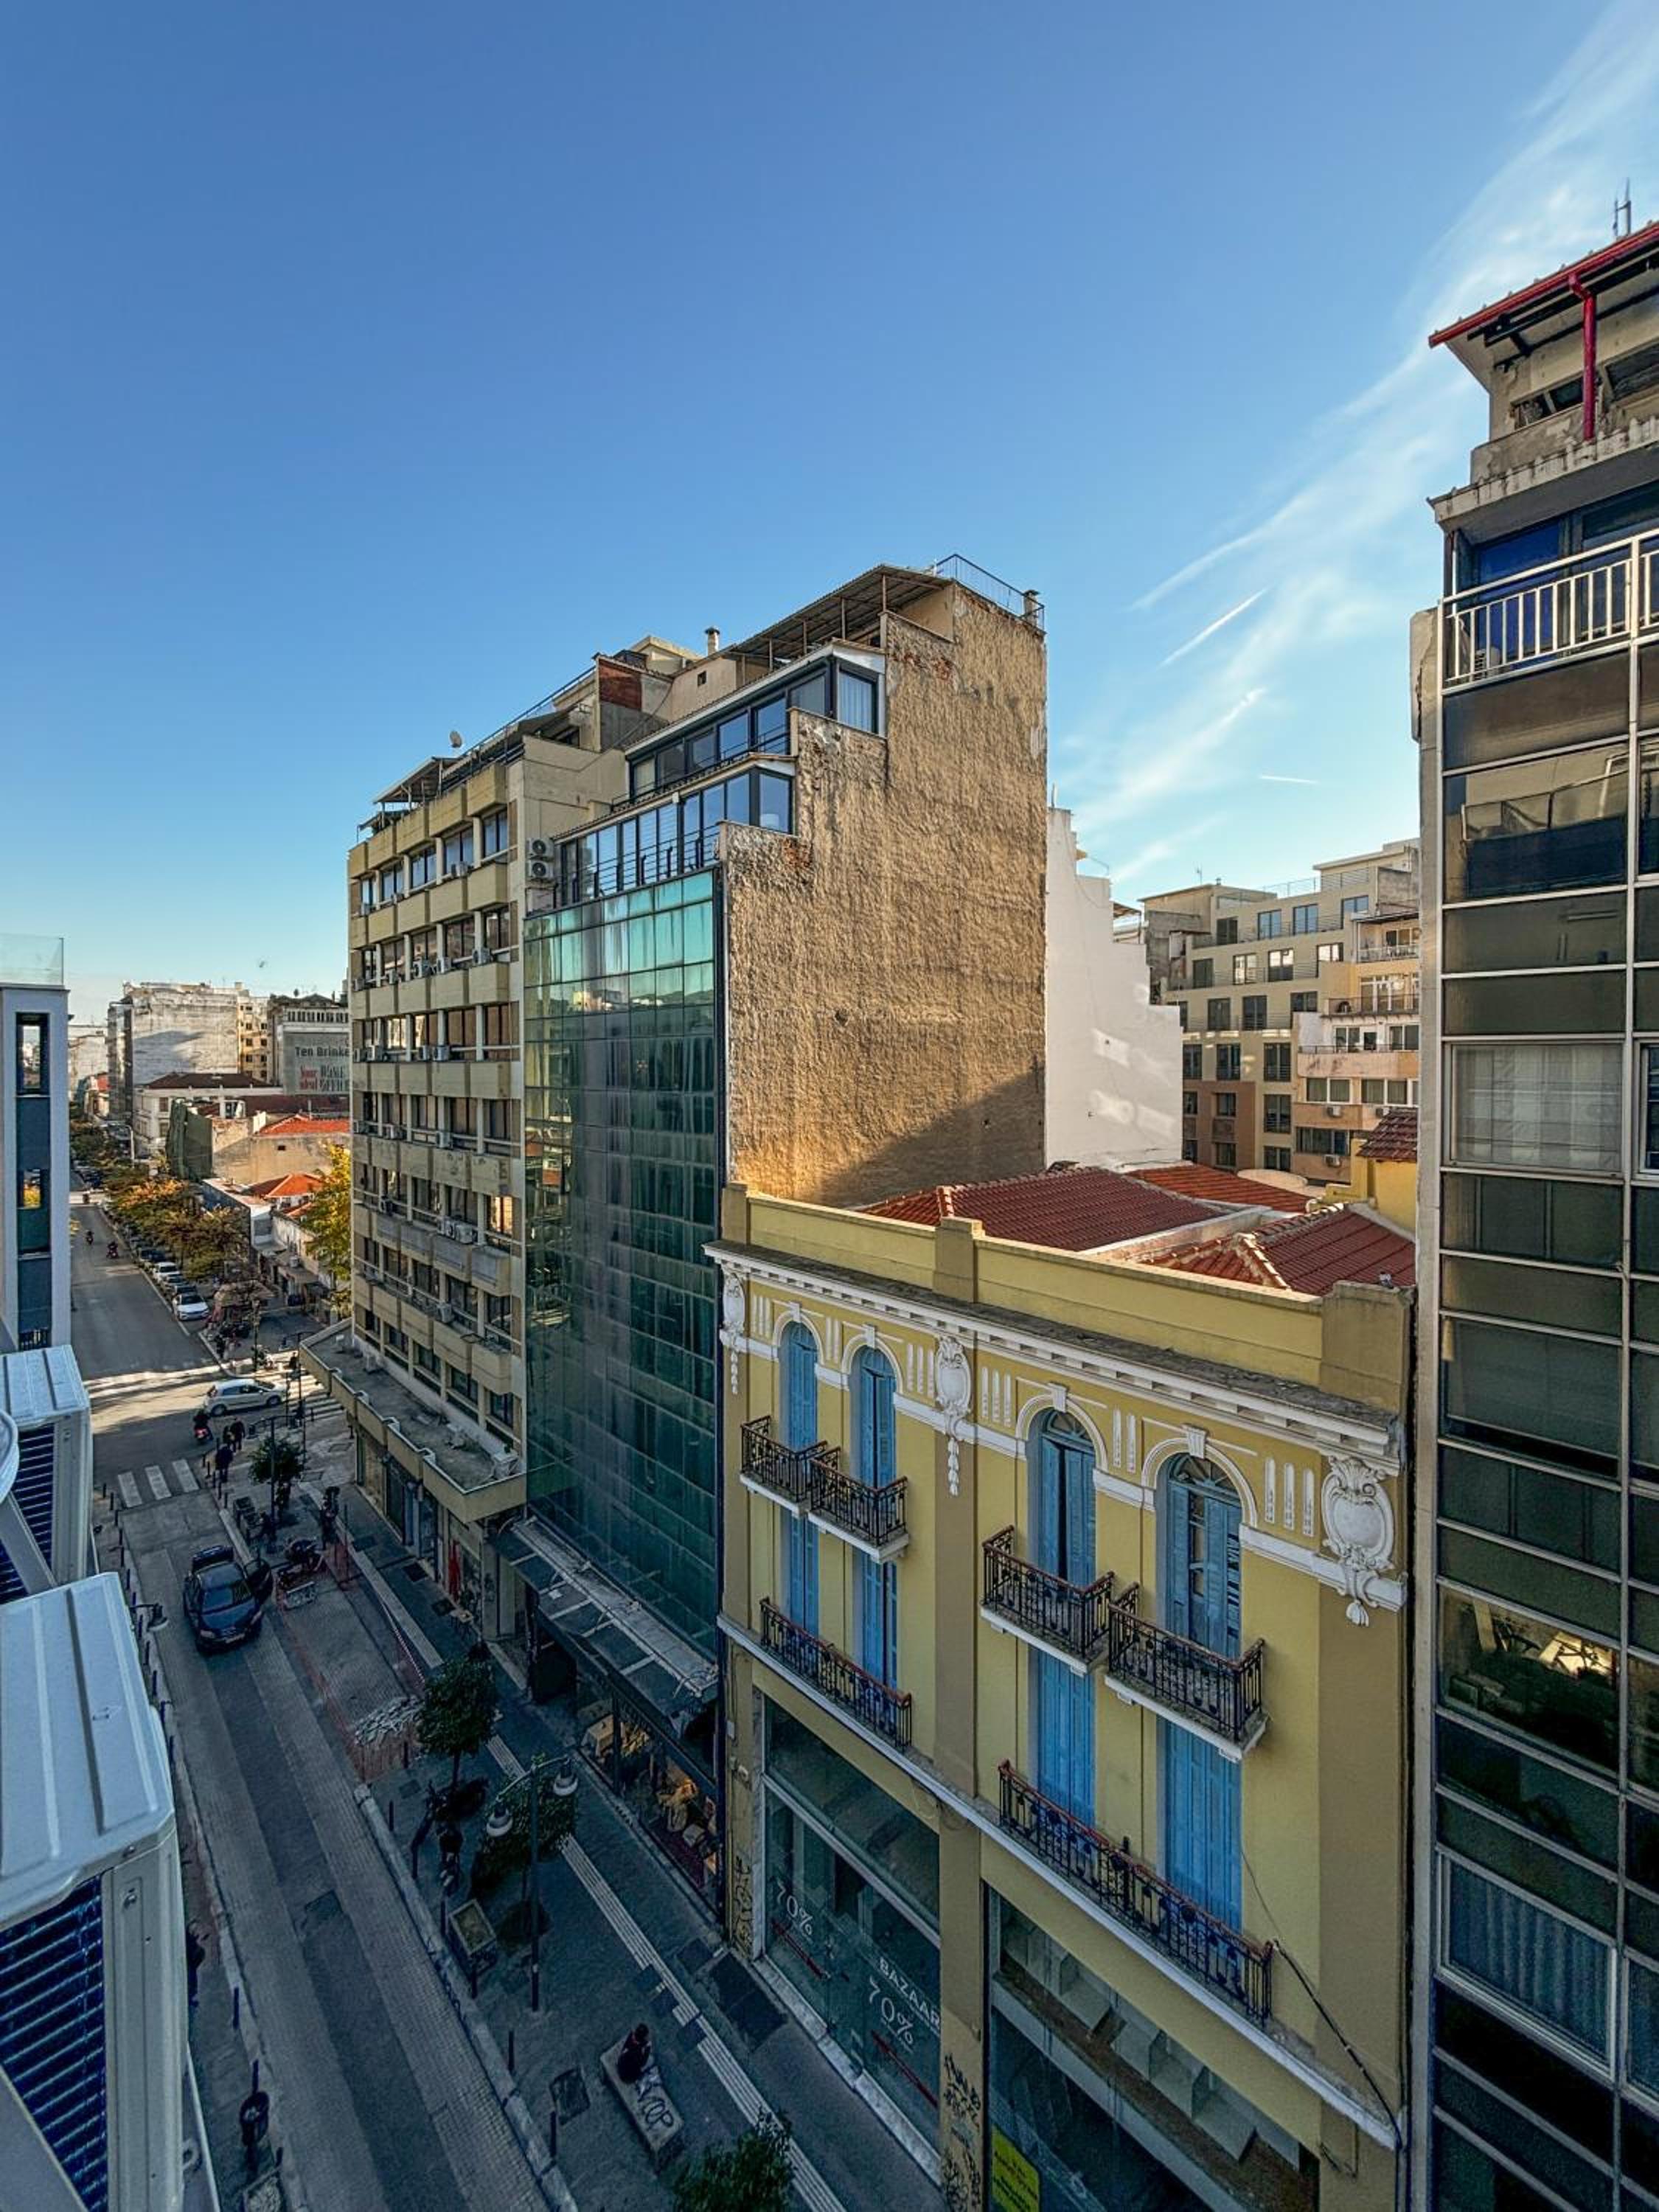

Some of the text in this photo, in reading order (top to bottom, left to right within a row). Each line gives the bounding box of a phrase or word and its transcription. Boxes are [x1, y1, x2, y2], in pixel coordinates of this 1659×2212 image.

[295, 1045, 349, 1057] Ten Brinke
[869, 1976, 914, 2045] 70%
[879, 1956, 940, 2029] BAZAAR
